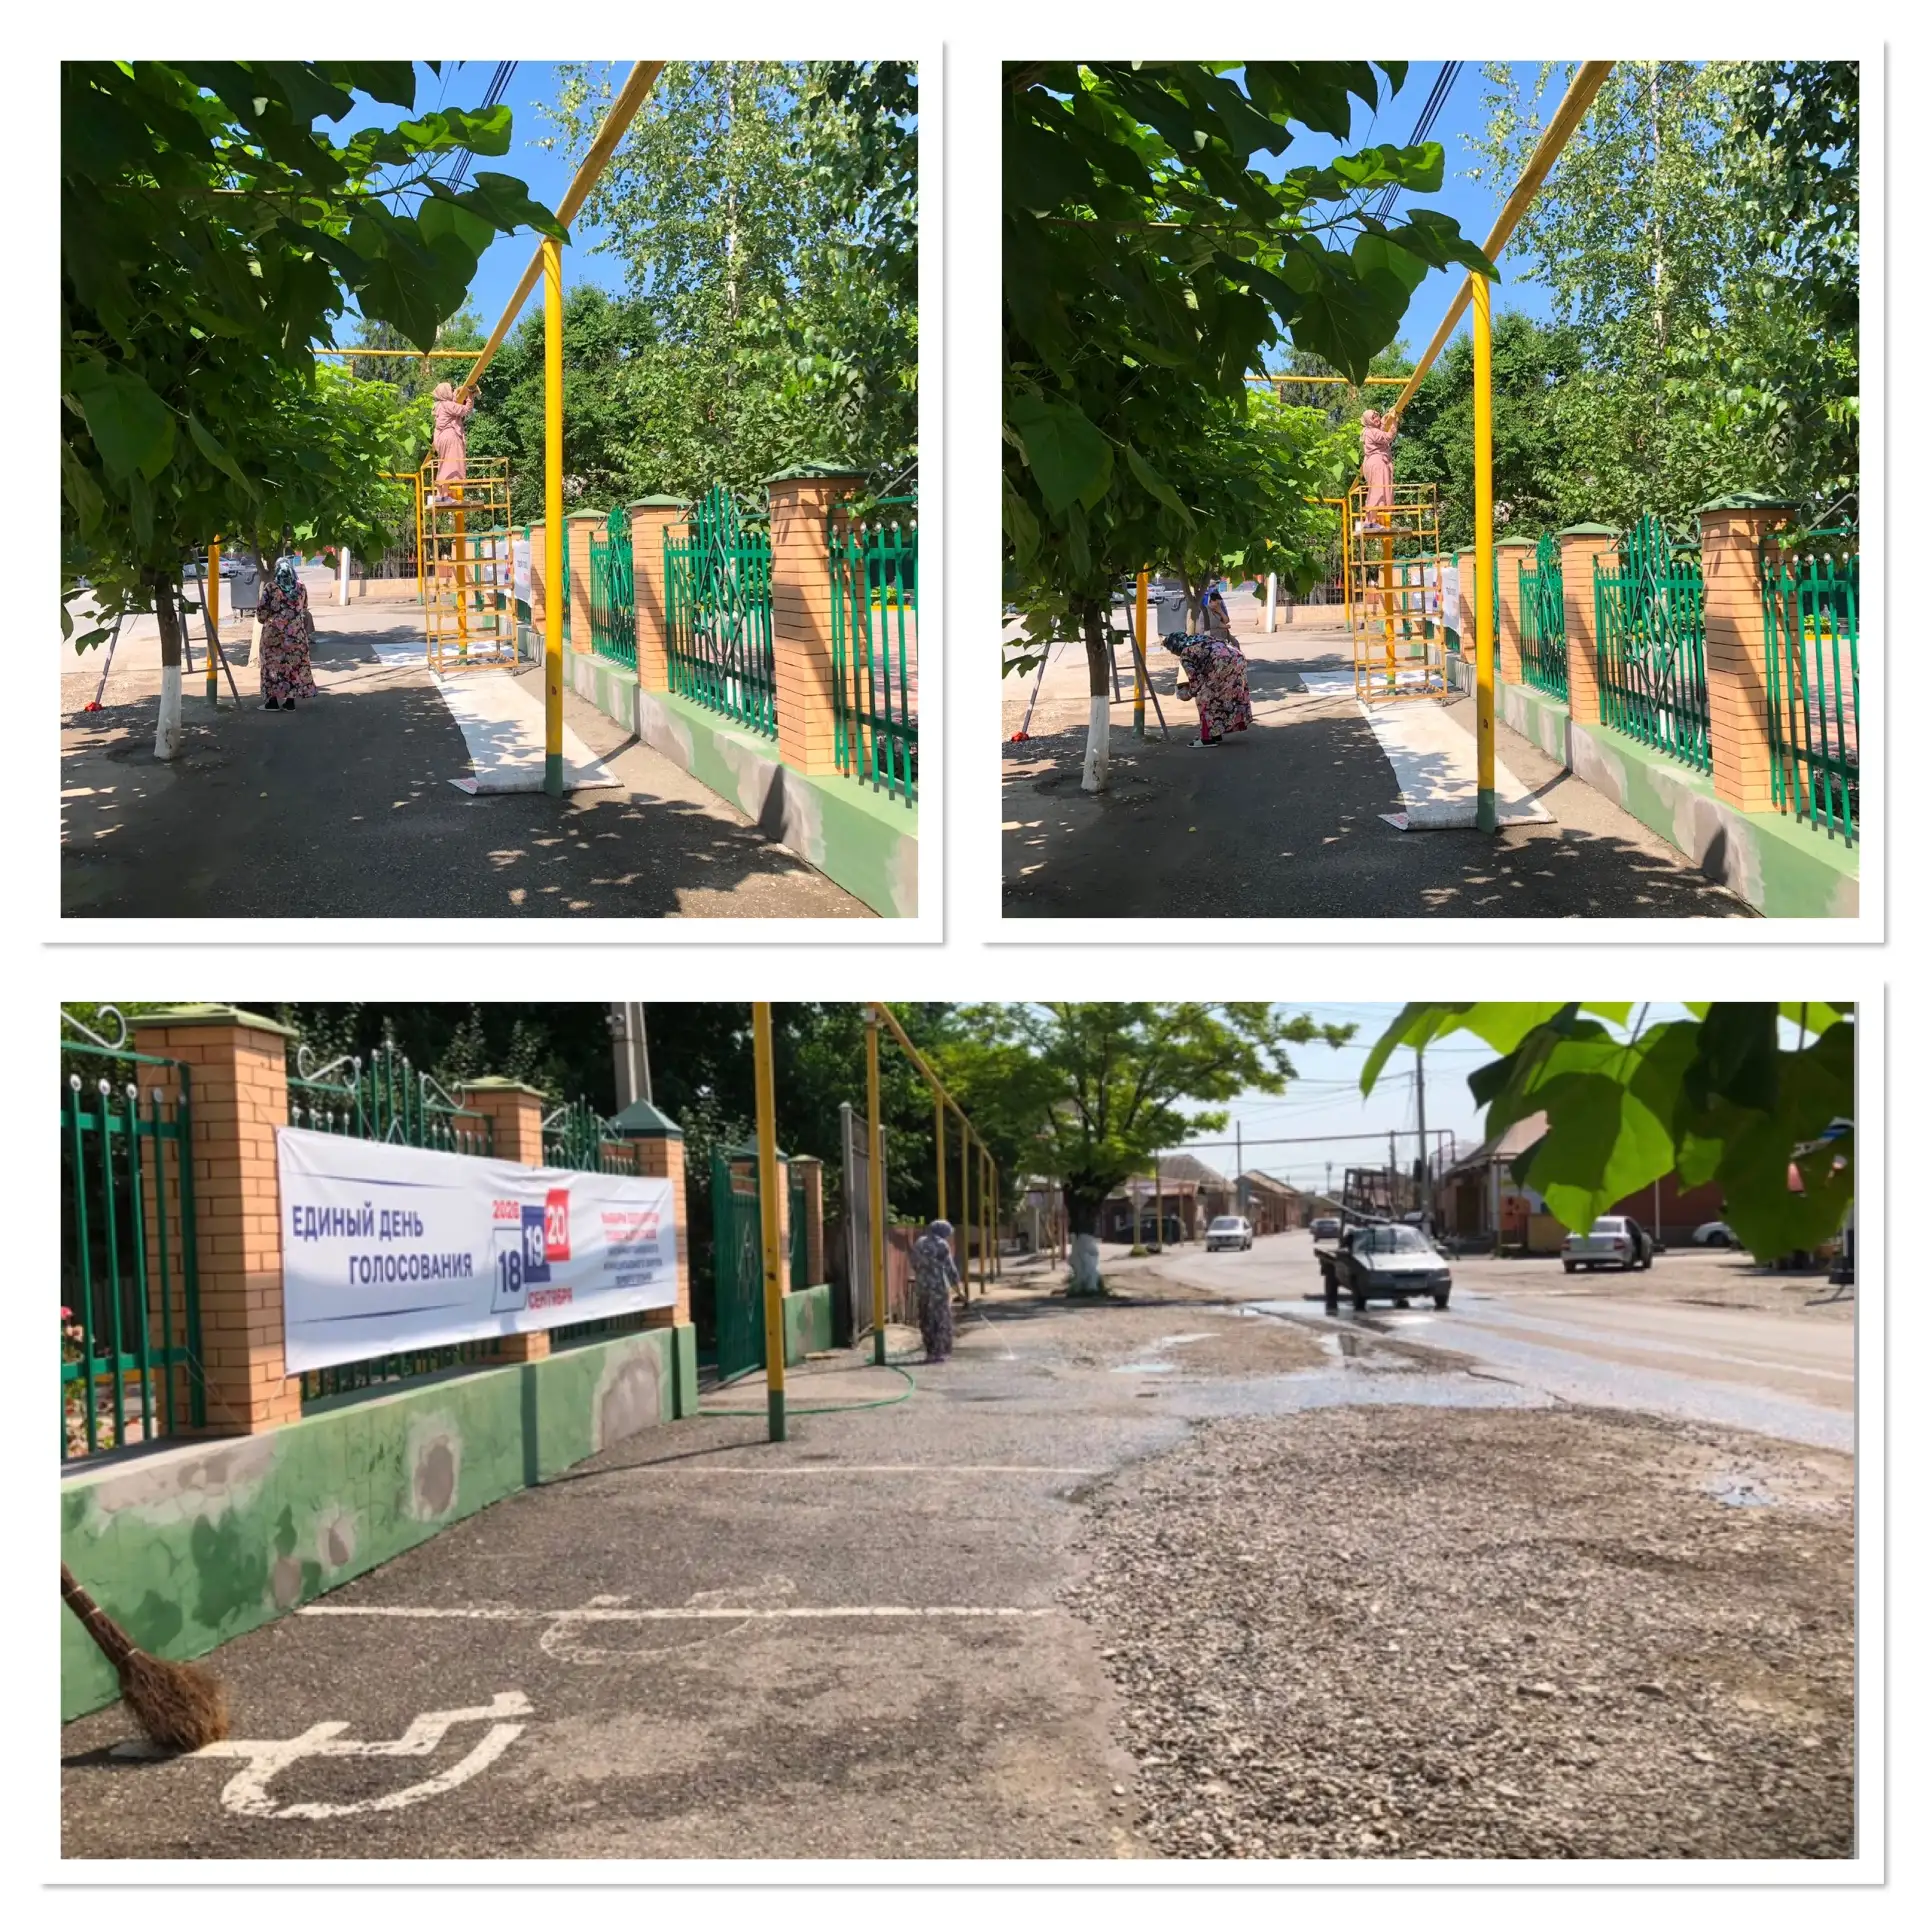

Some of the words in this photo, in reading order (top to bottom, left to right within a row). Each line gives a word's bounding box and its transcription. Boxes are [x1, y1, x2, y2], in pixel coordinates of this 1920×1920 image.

[292, 1202, 375, 1241] ЕДИНЫЙ
[379, 1210, 424, 1241] ДЕНЬ
[348, 1253, 473, 1285] ГОЛОСОВАНИЯ
[498, 1250, 521, 1293] 18
[525, 1225, 544, 1267] 19
[546, 1206, 567, 1245] 20
